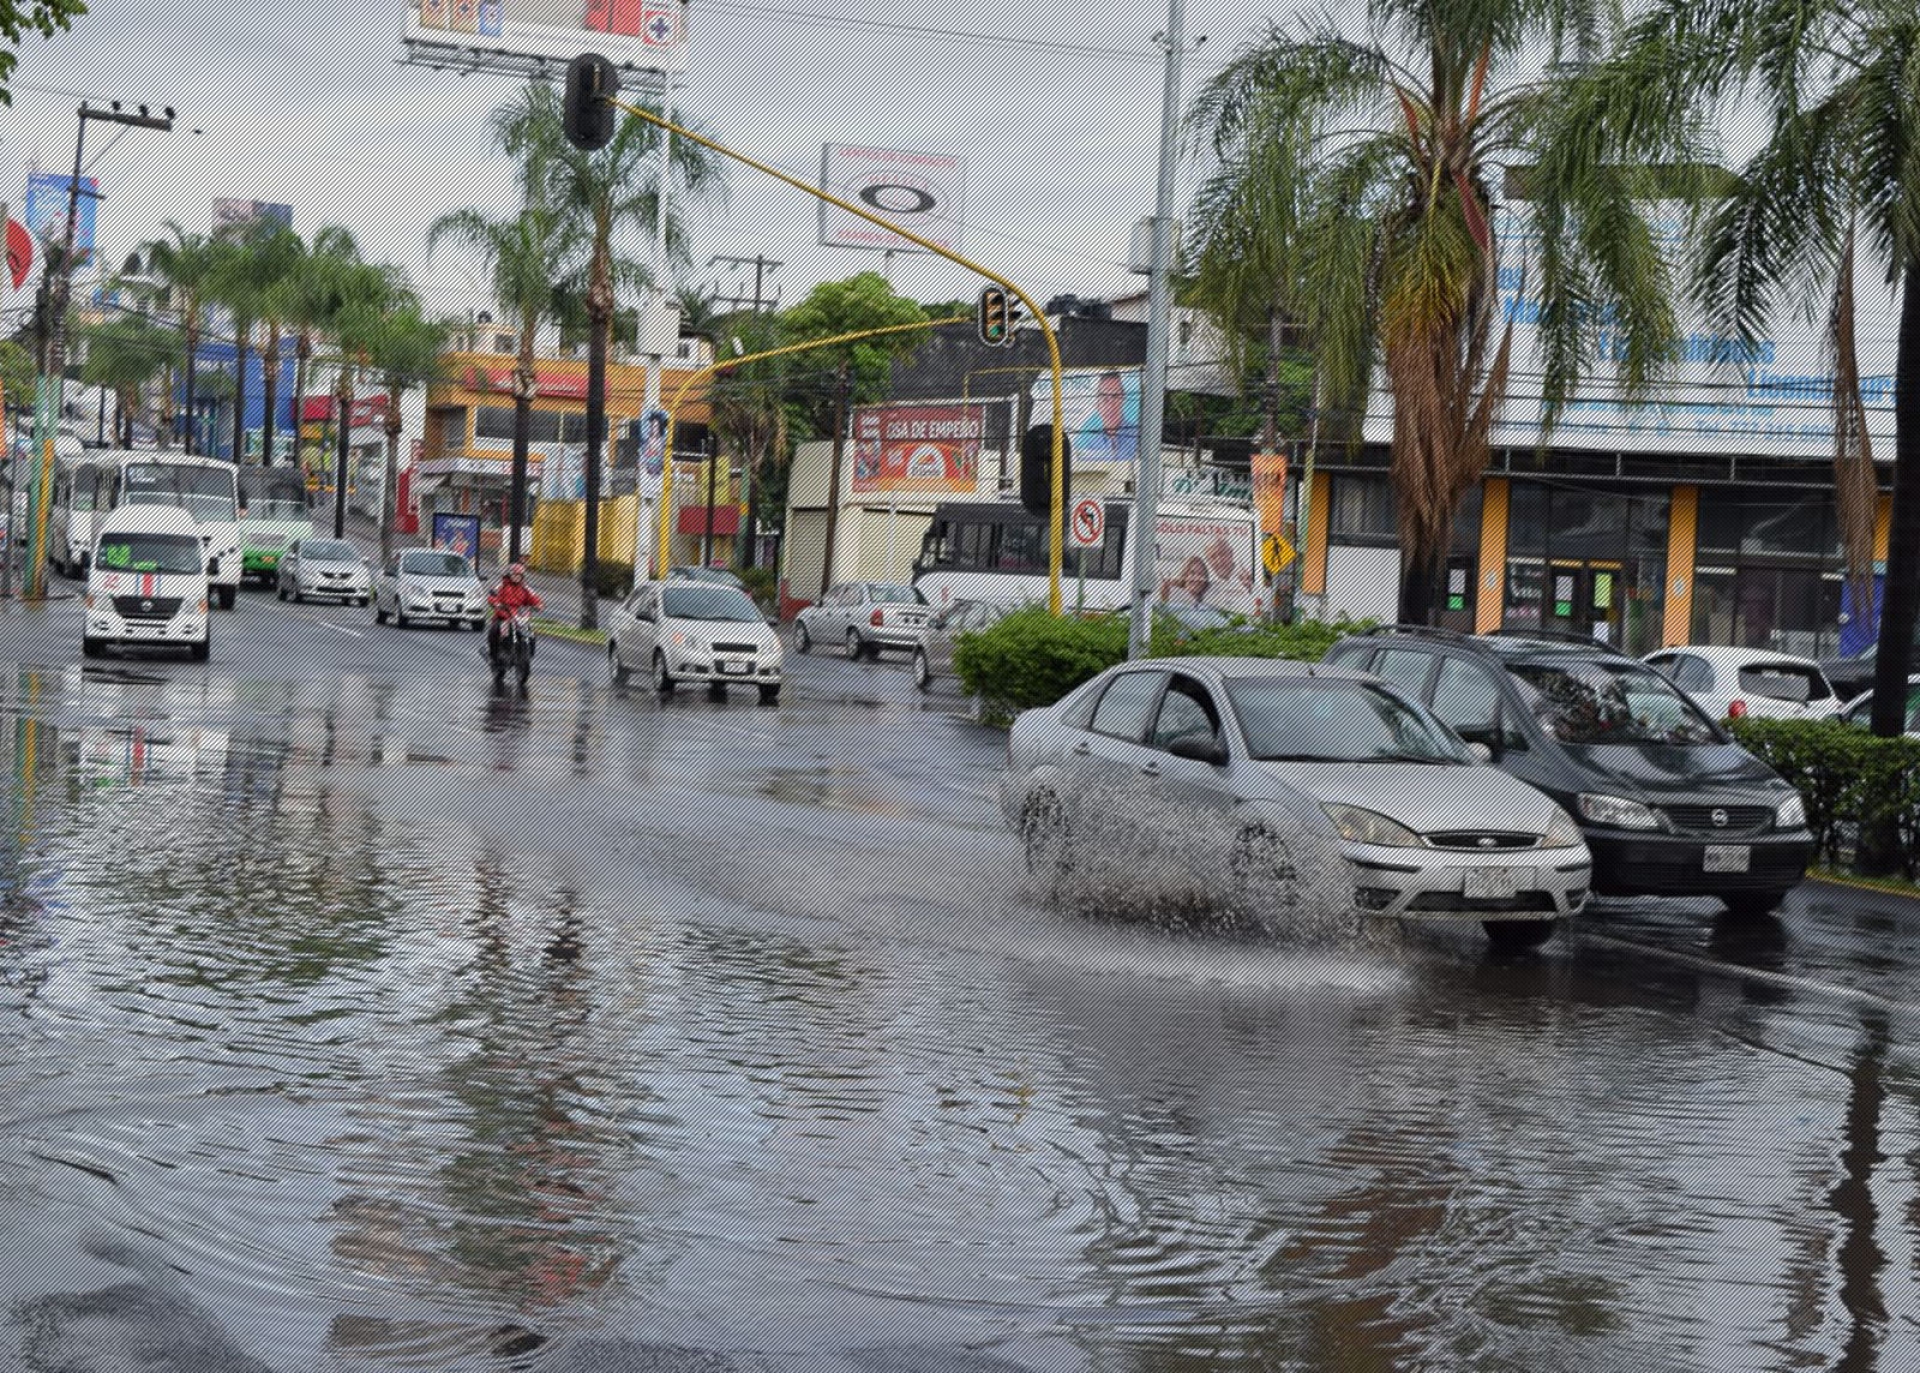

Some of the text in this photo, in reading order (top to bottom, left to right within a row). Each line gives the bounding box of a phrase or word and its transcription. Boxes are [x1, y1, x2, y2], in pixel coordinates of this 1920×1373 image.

[839, 147, 957, 169] LENTES DE CONTACTO
[911, 420, 928, 439] DE
